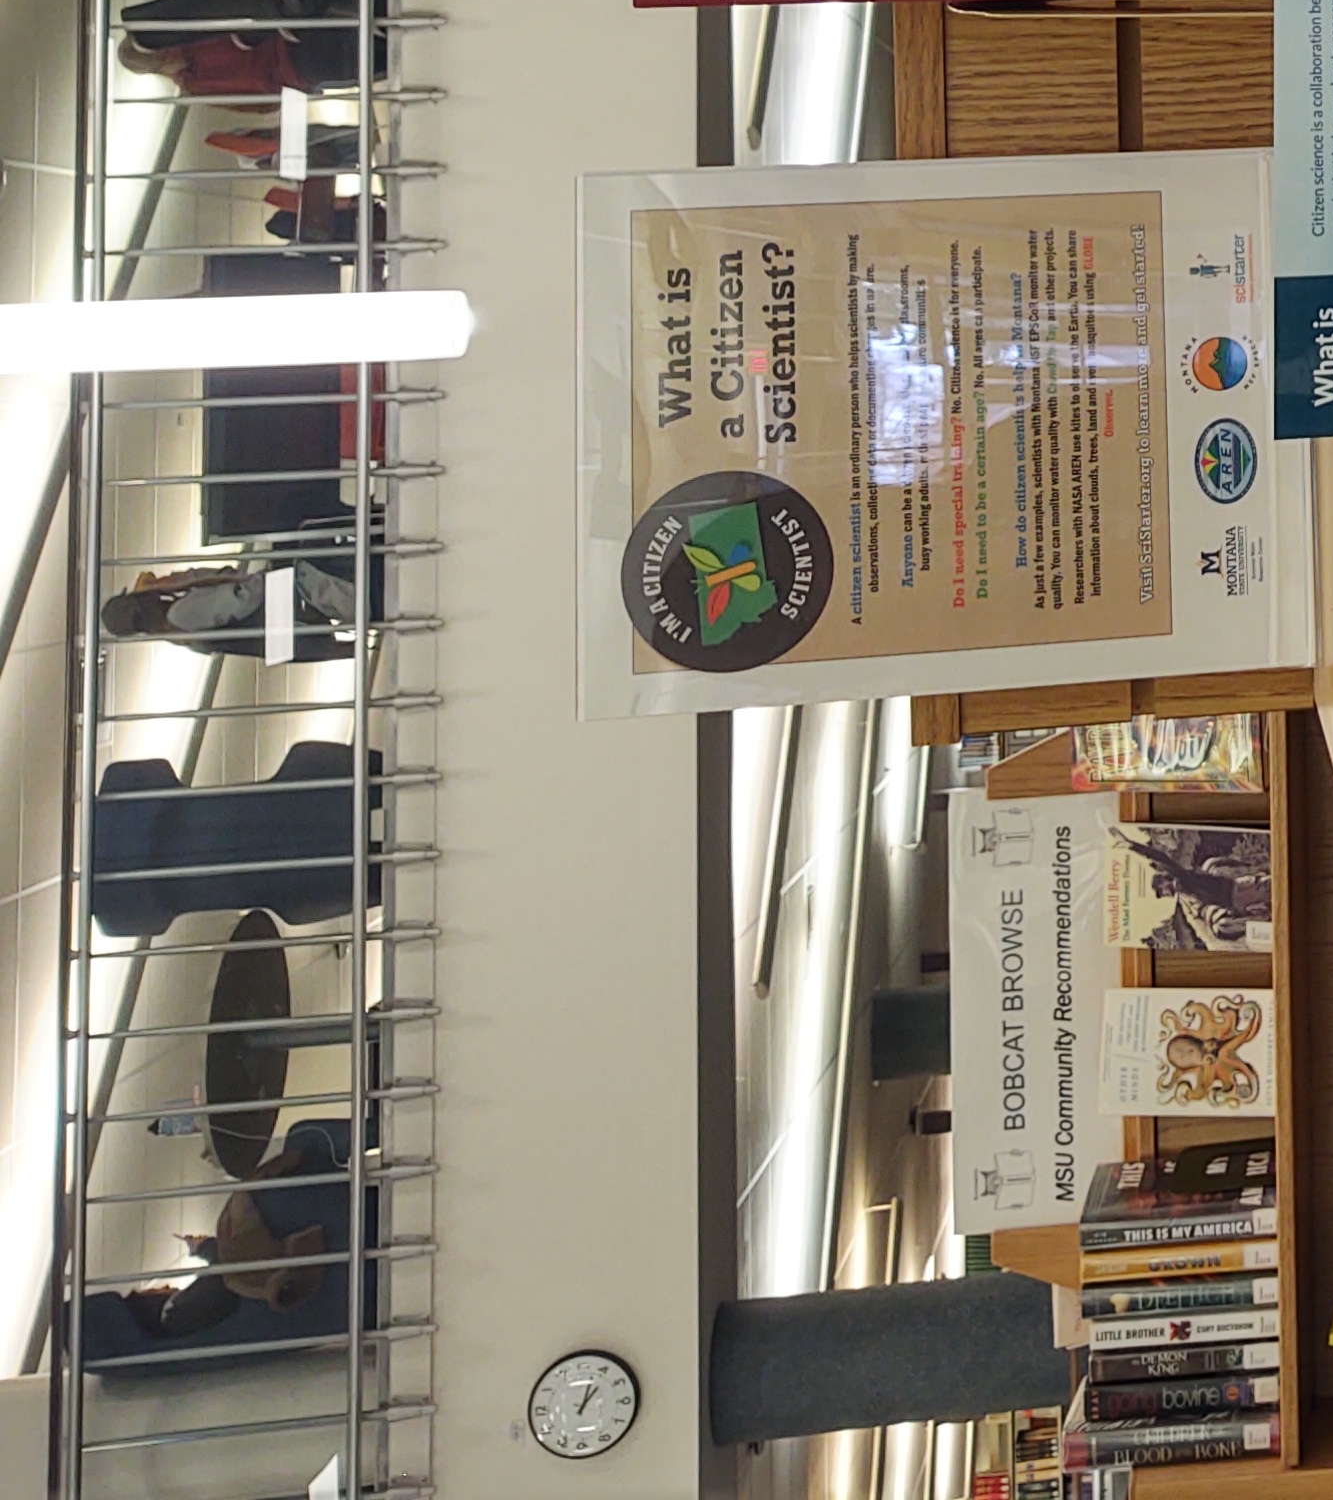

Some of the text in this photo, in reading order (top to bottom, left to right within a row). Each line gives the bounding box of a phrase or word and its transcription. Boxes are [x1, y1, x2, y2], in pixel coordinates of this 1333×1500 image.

[1308, 17, 1323, 107] collaboration
[1311, 121, 1324, 132] is
[1313, 110, 1324, 118] a
[1311, 135, 1324, 185] science
[1311, 188, 1325, 237] Citizen
[657, 268, 693, 427] What is
[709, 250, 745, 439] a Citizen
[761, 242, 796, 444] Scientist?
[1220, 428, 1233, 495] AREN
[642, 515, 683, 597] CITIZEN
[770, 506, 813, 620] SCIENTIST
[649, 597, 670, 615] A
[1001, 889, 1026, 1131] BOBCAT BROWSE
[1052, 826, 1077, 1202] MSU Community Recommendations
[1124, 1220, 1253, 1242] THIS IS MY AMERICA
[1095, 1327, 1165, 1342] LITTLE BROTHER
